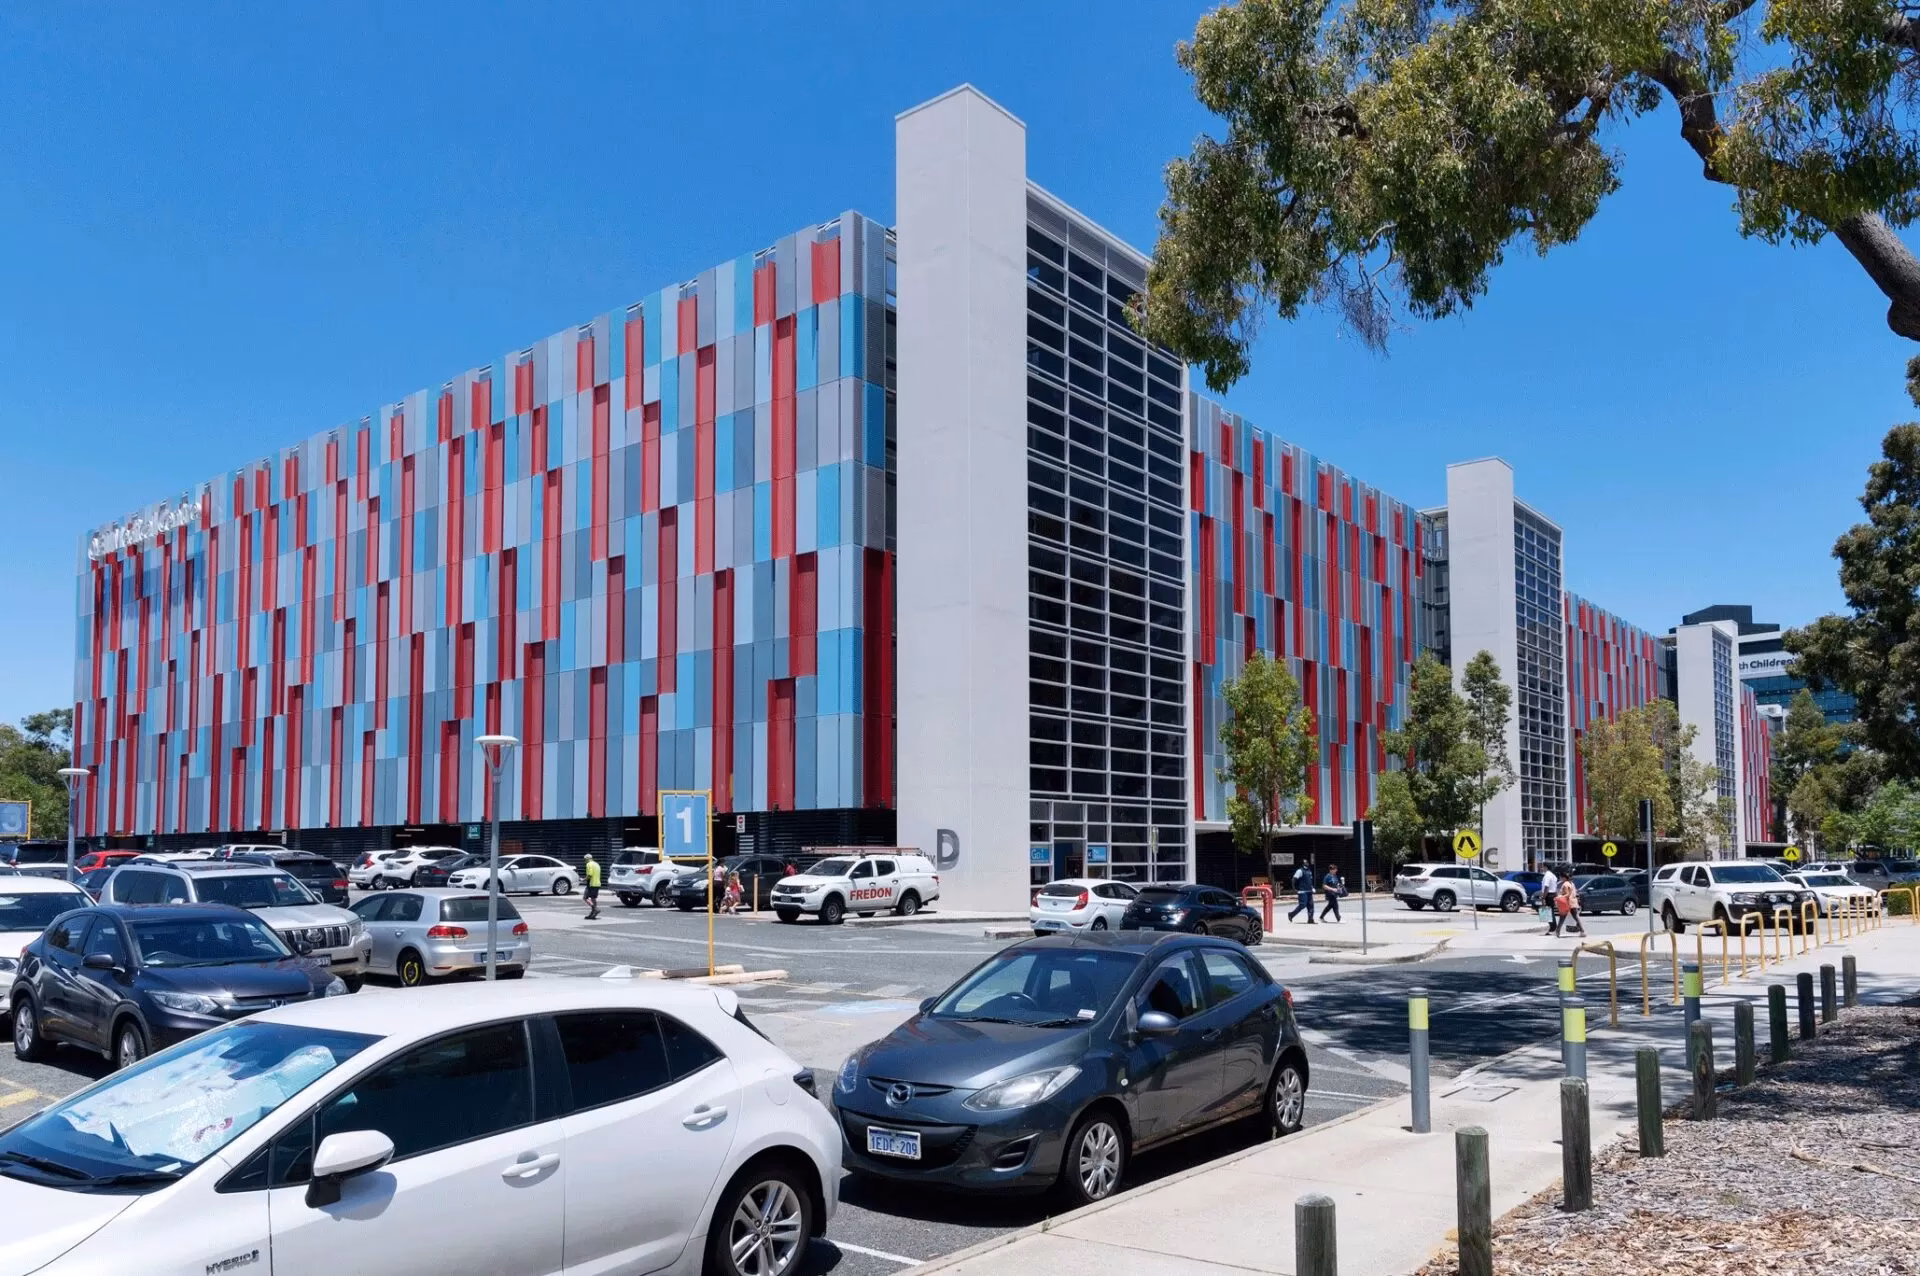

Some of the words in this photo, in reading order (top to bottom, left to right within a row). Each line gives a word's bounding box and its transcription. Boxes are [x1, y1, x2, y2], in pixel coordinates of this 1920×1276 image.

[676, 807, 691, 843] 1
[937, 829, 960, 864] D
[1484, 847, 1498, 866] C
[850, 888, 892, 900] FREDON
[206, 1253, 251, 1276] HYBRID
